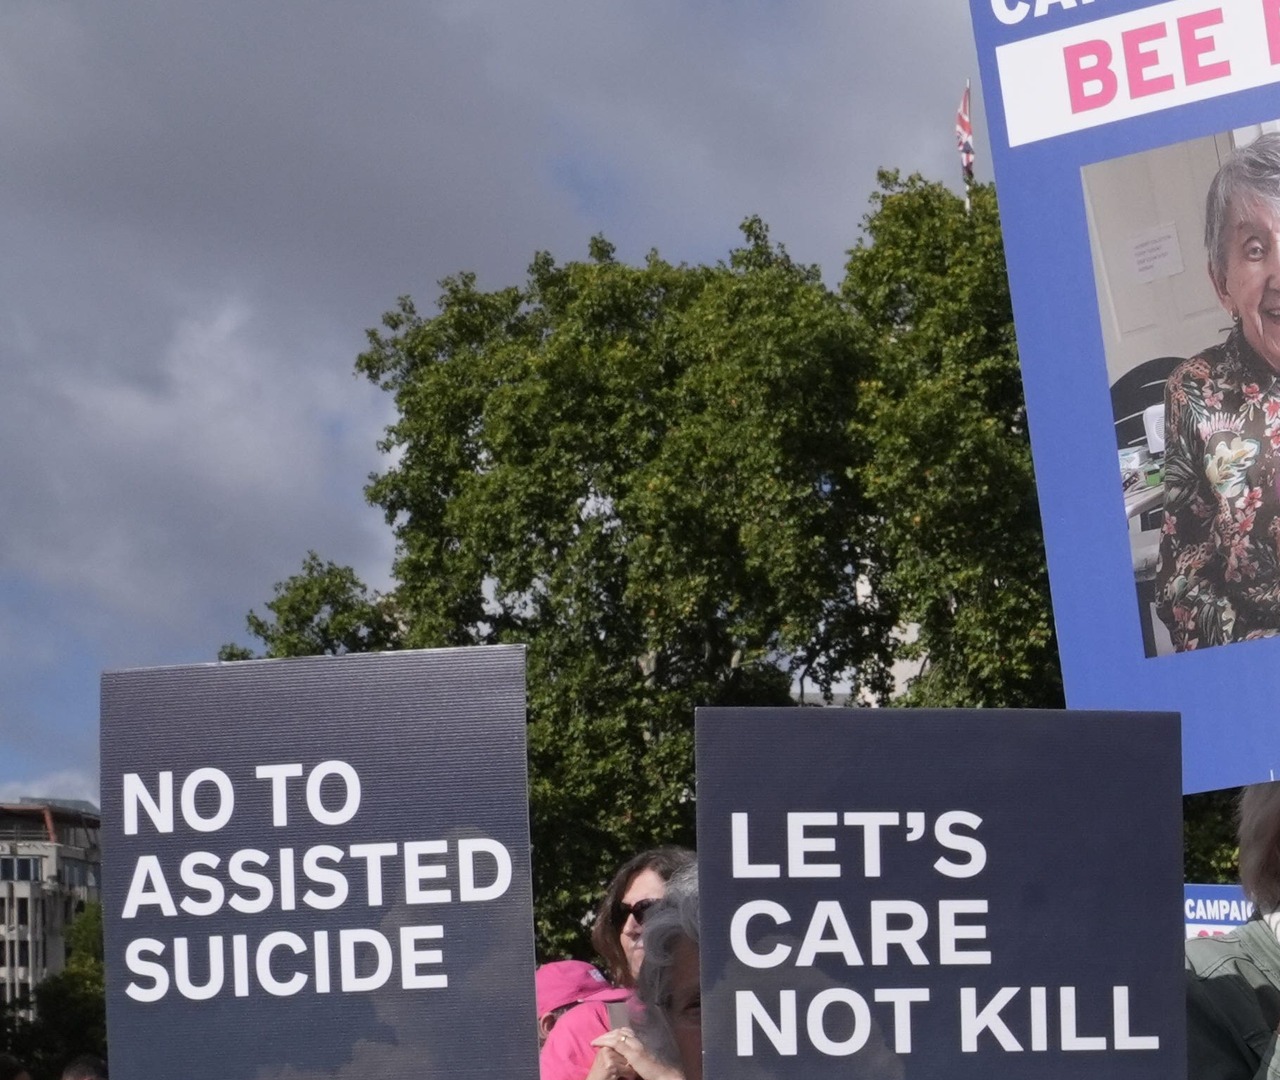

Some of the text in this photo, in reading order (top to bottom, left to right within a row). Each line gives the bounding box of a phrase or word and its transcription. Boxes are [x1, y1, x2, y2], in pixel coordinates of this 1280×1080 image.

[1063, 8, 1231, 114] BEE
[122, 760, 362, 836] NO TO
[121, 837, 513, 919] ASSISTED
[731, 810, 988, 878] LET'S
[124, 925, 448, 1002] SUICIDE
[729, 900, 992, 968] CARE
[735, 985, 1160, 1056] NOT KILL
